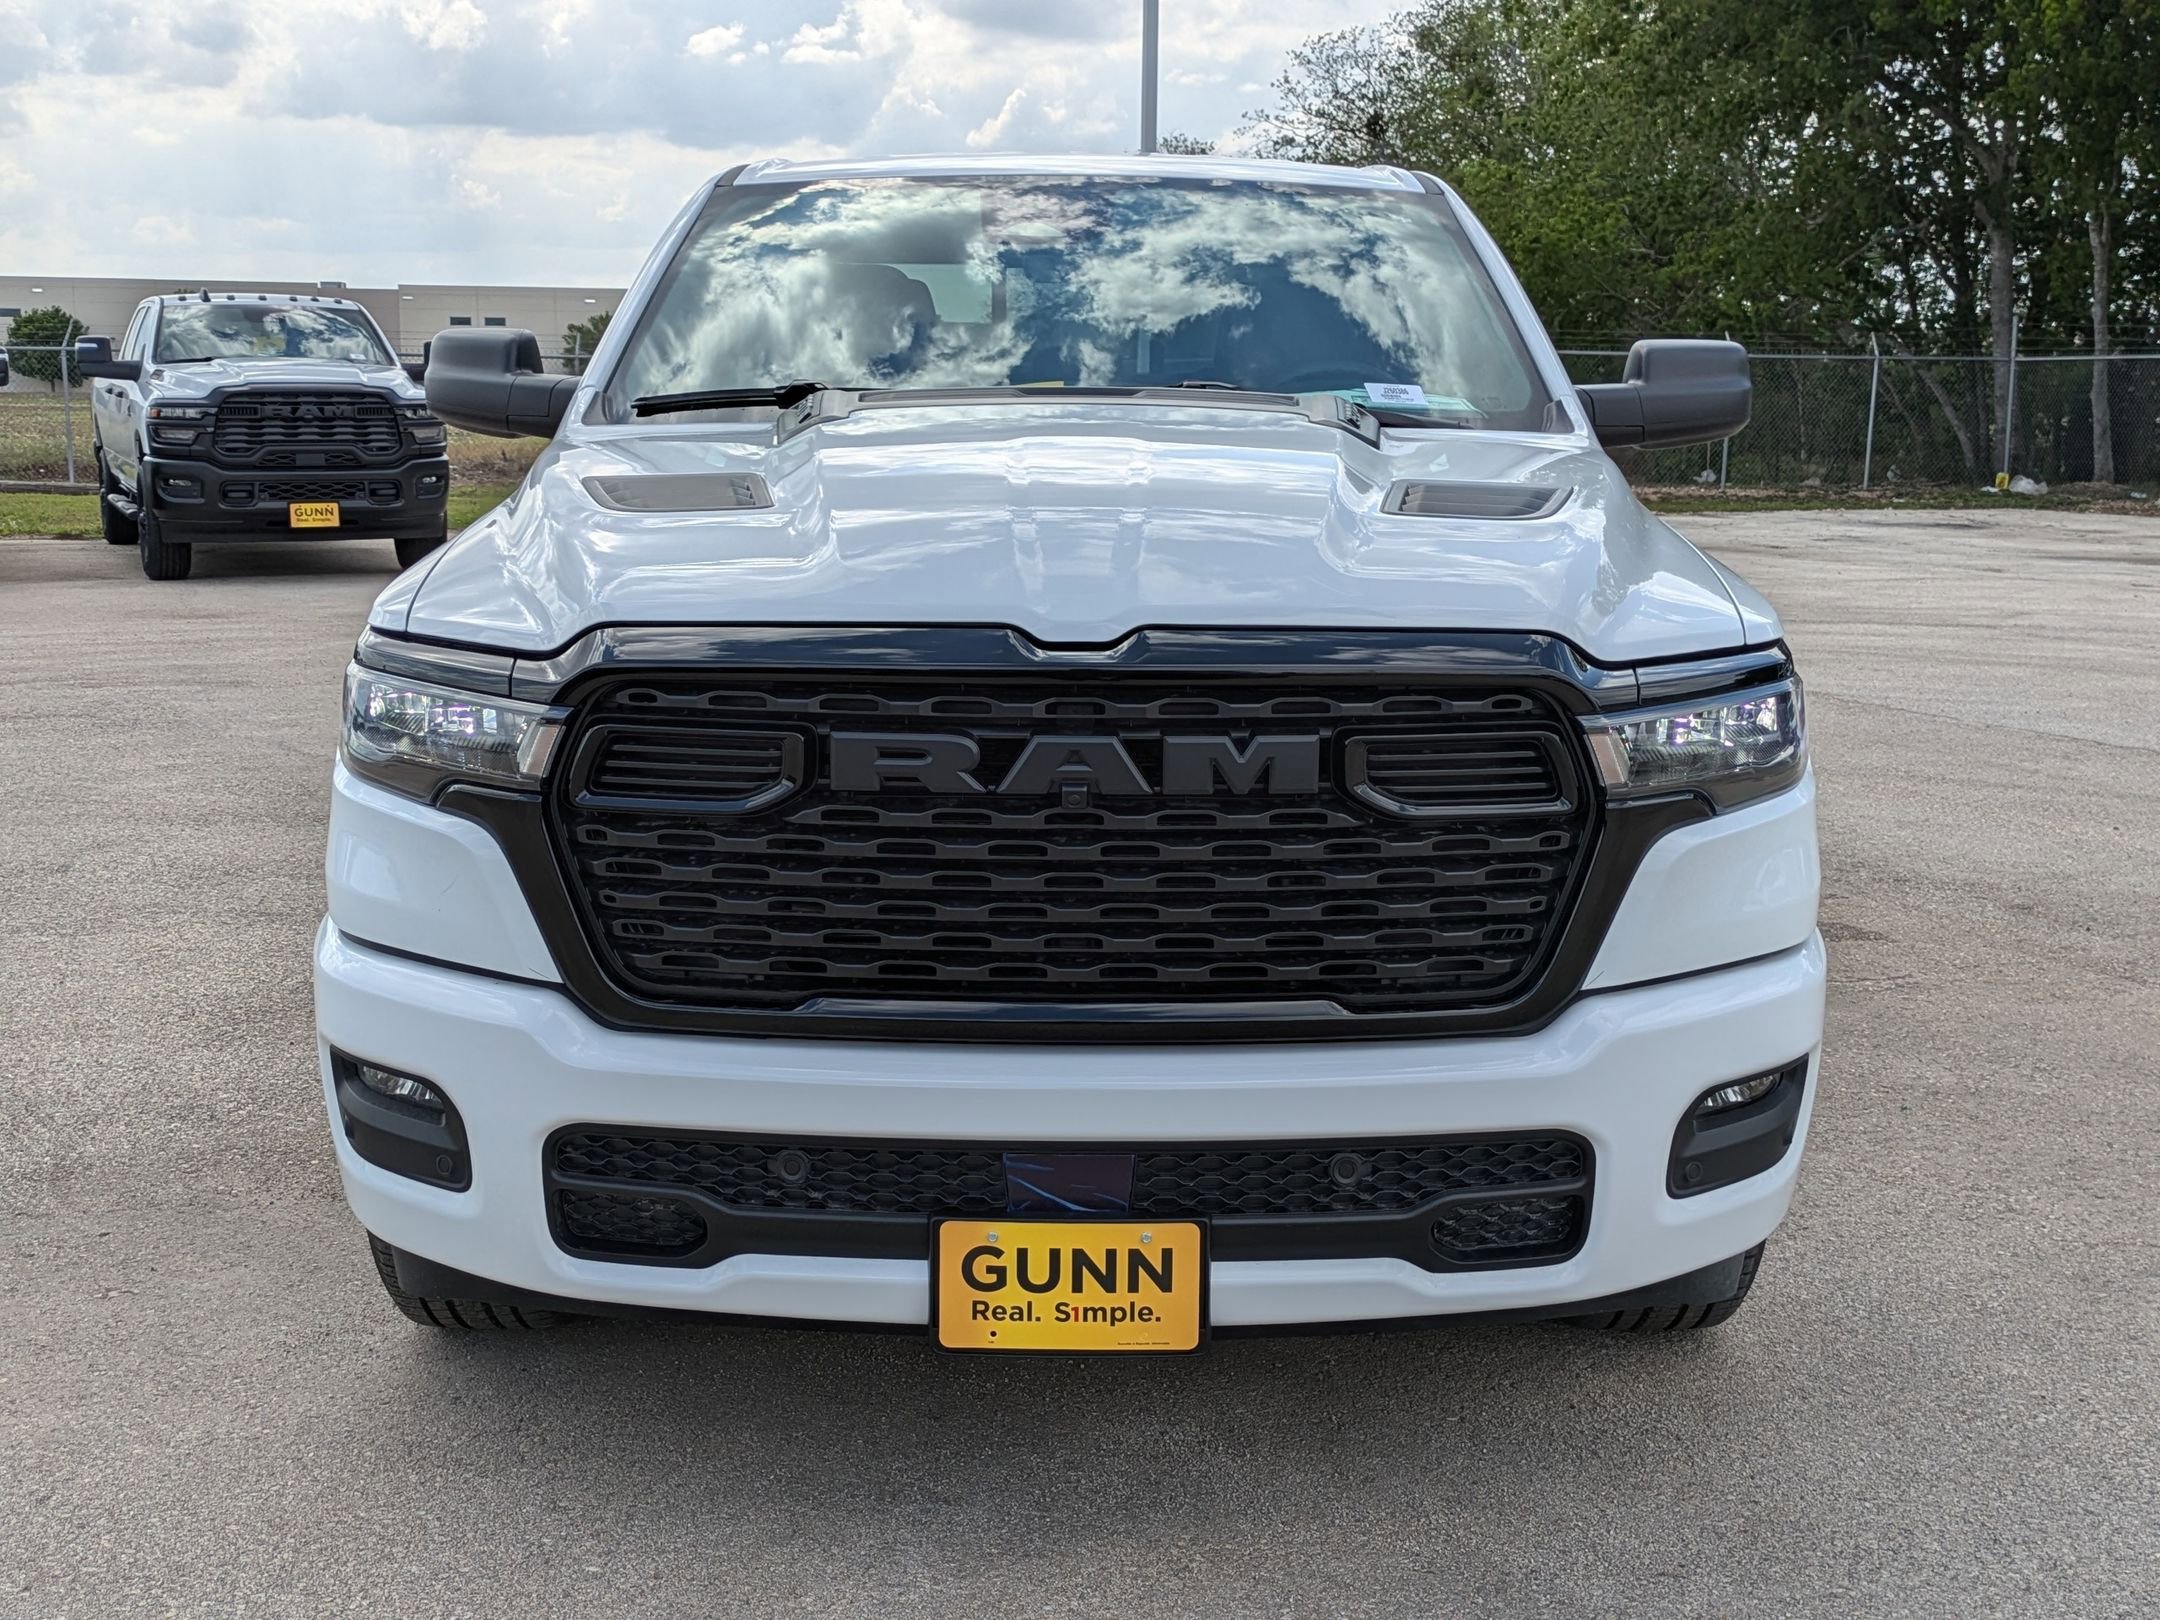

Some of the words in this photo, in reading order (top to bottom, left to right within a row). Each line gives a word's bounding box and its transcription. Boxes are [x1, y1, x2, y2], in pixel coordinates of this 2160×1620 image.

[294, 507, 334, 517] GUNN
[830, 731, 1319, 795] RAM
[961, 1245, 1173, 1294] GUNN
[971, 1300, 1041, 1322] Real.
